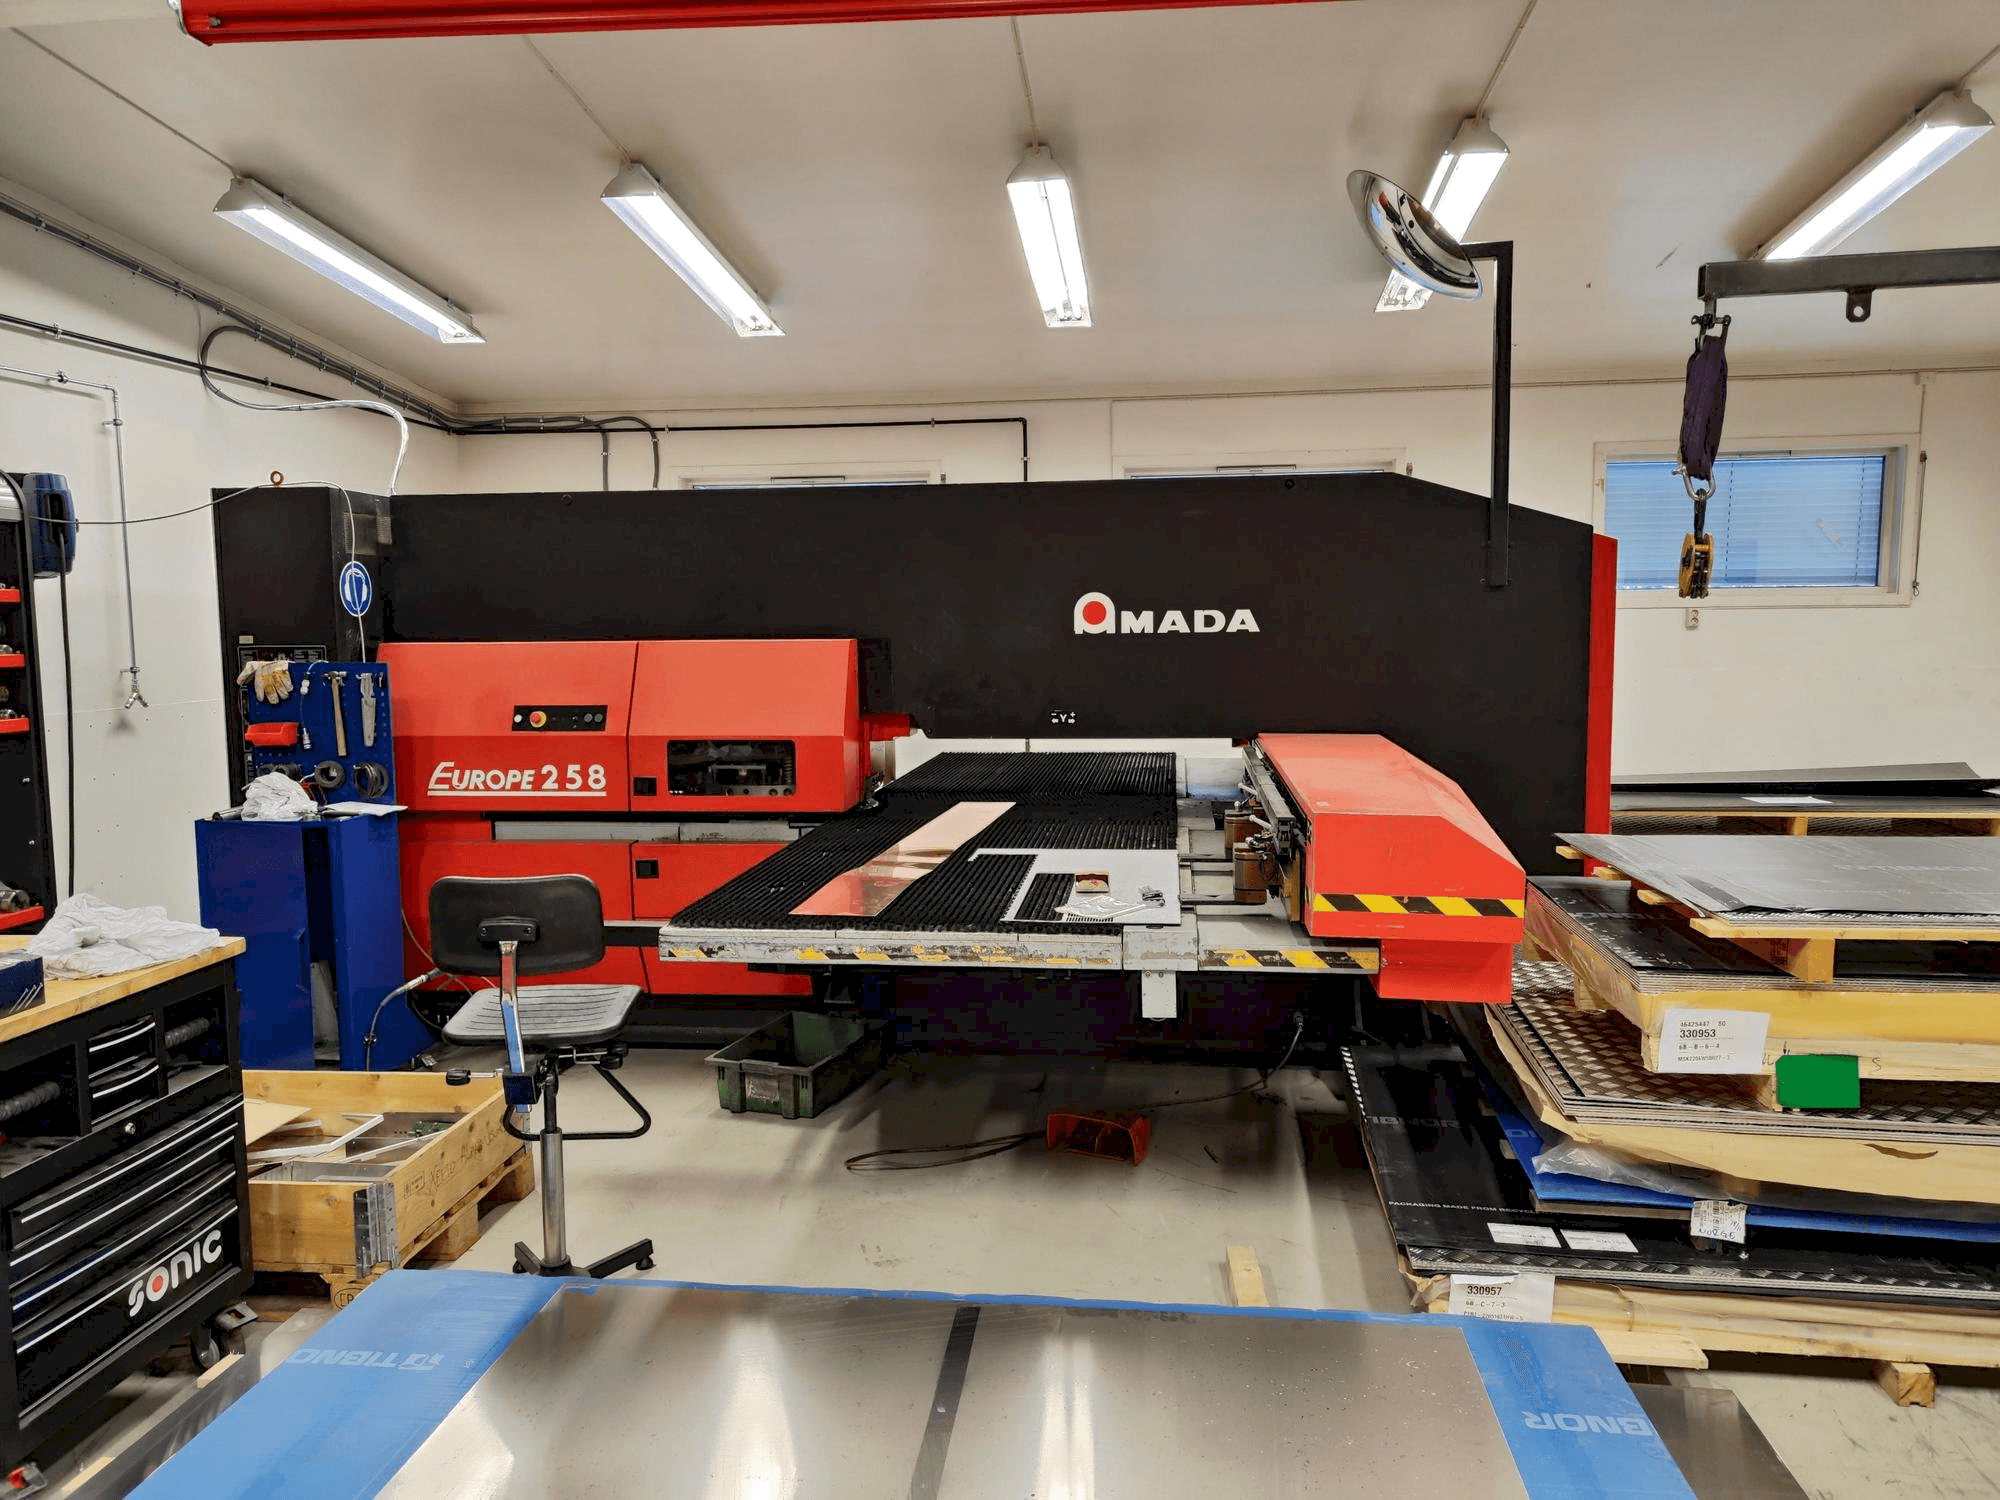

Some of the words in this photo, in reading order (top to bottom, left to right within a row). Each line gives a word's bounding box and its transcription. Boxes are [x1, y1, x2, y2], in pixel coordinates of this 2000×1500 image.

[1074, 592, 1260, 634] AMADA
[428, 762, 536, 790] EUROPE
[1679, 1029, 1716, 1039] 330953
[1467, 1285, 1502, 1296] 330957
[1521, 1411, 1654, 1437] BNOR
